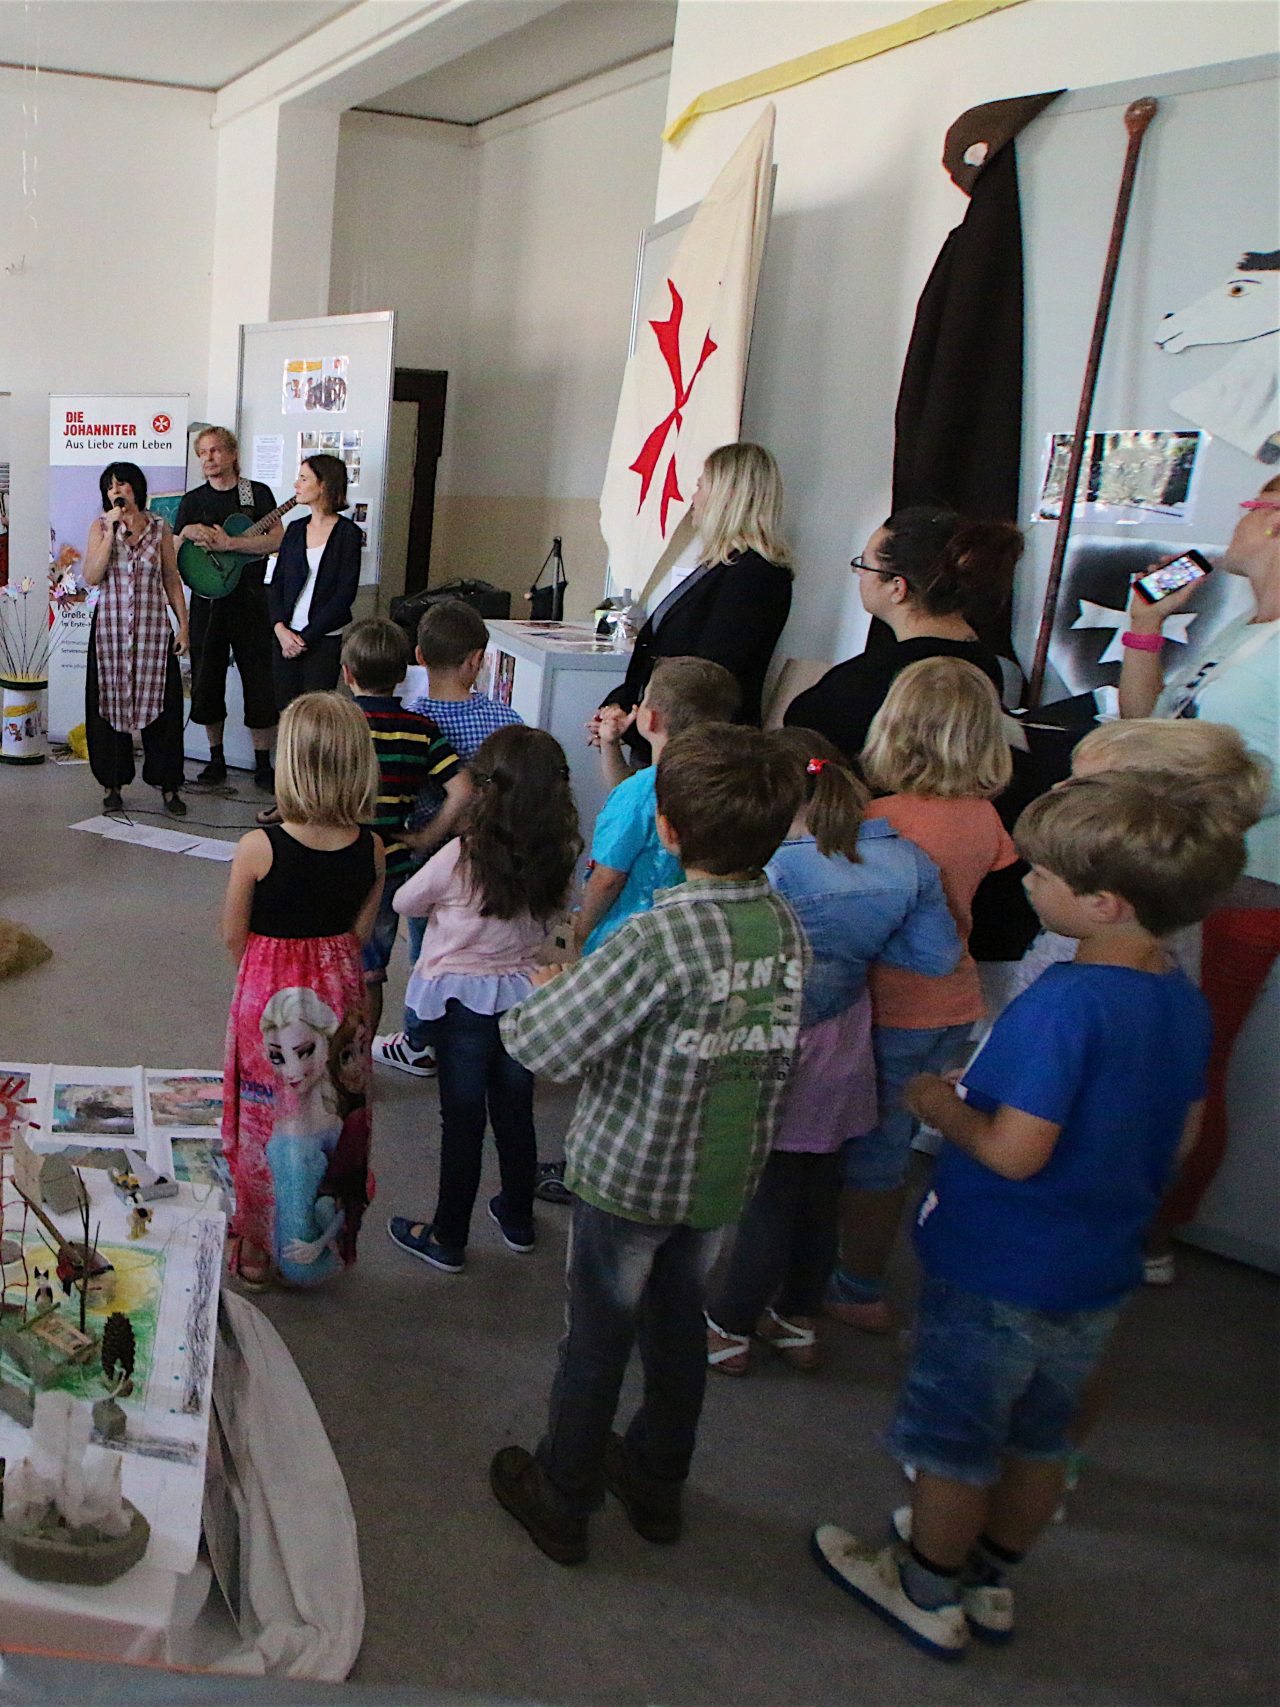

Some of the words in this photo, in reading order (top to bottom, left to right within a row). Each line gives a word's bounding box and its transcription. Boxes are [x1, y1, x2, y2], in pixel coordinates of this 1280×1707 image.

[65, 411, 84, 423] DIE
[63, 424, 137, 436] JOHANNITER
[65, 439, 84, 449] Aus
[87, 439, 114, 450] Liebe
[117, 441, 138, 450] zum
[142, 440, 172, 450] Leben
[61, 610, 86, 619] Große
[674, 1024, 800, 1060] COMPAN
